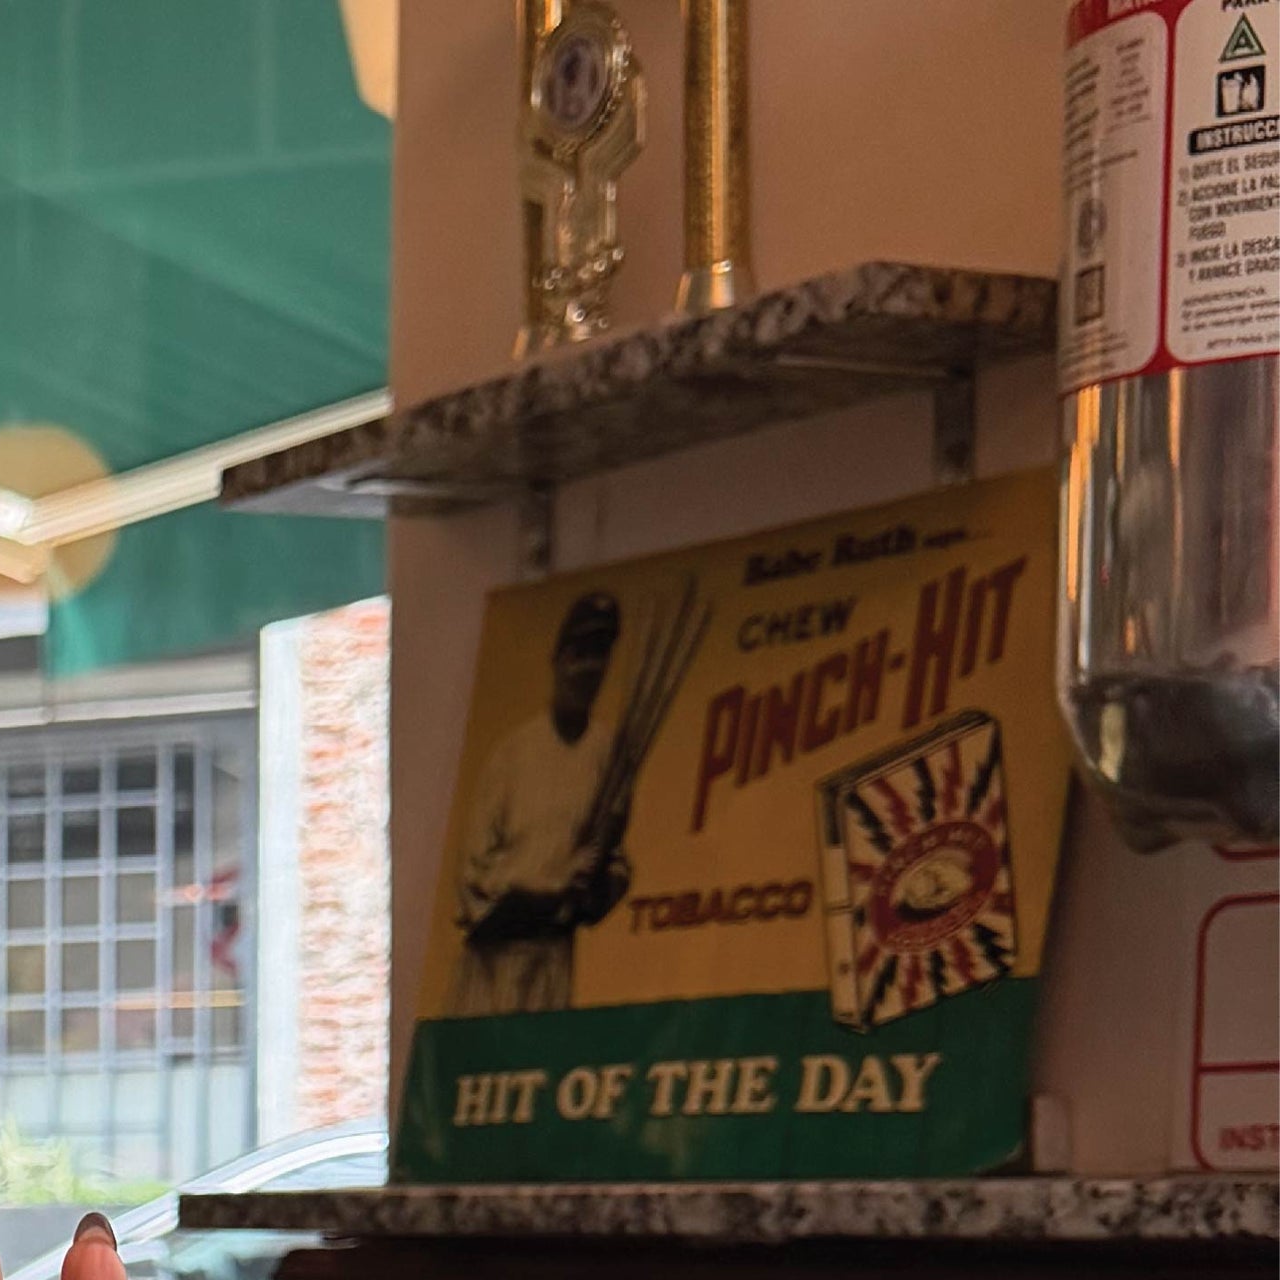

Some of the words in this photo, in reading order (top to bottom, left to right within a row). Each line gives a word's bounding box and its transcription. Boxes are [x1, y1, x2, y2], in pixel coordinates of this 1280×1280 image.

[737, 594, 858, 653] CHEW
[689, 554, 1031, 834] PINCH-HIT
[630, 881, 813, 934] TOBACCO
[454, 1071, 547, 1127] HIT
[556, 1063, 636, 1121] OF
[647, 1054, 780, 1117] THE
[795, 1051, 943, 1115] DAY
